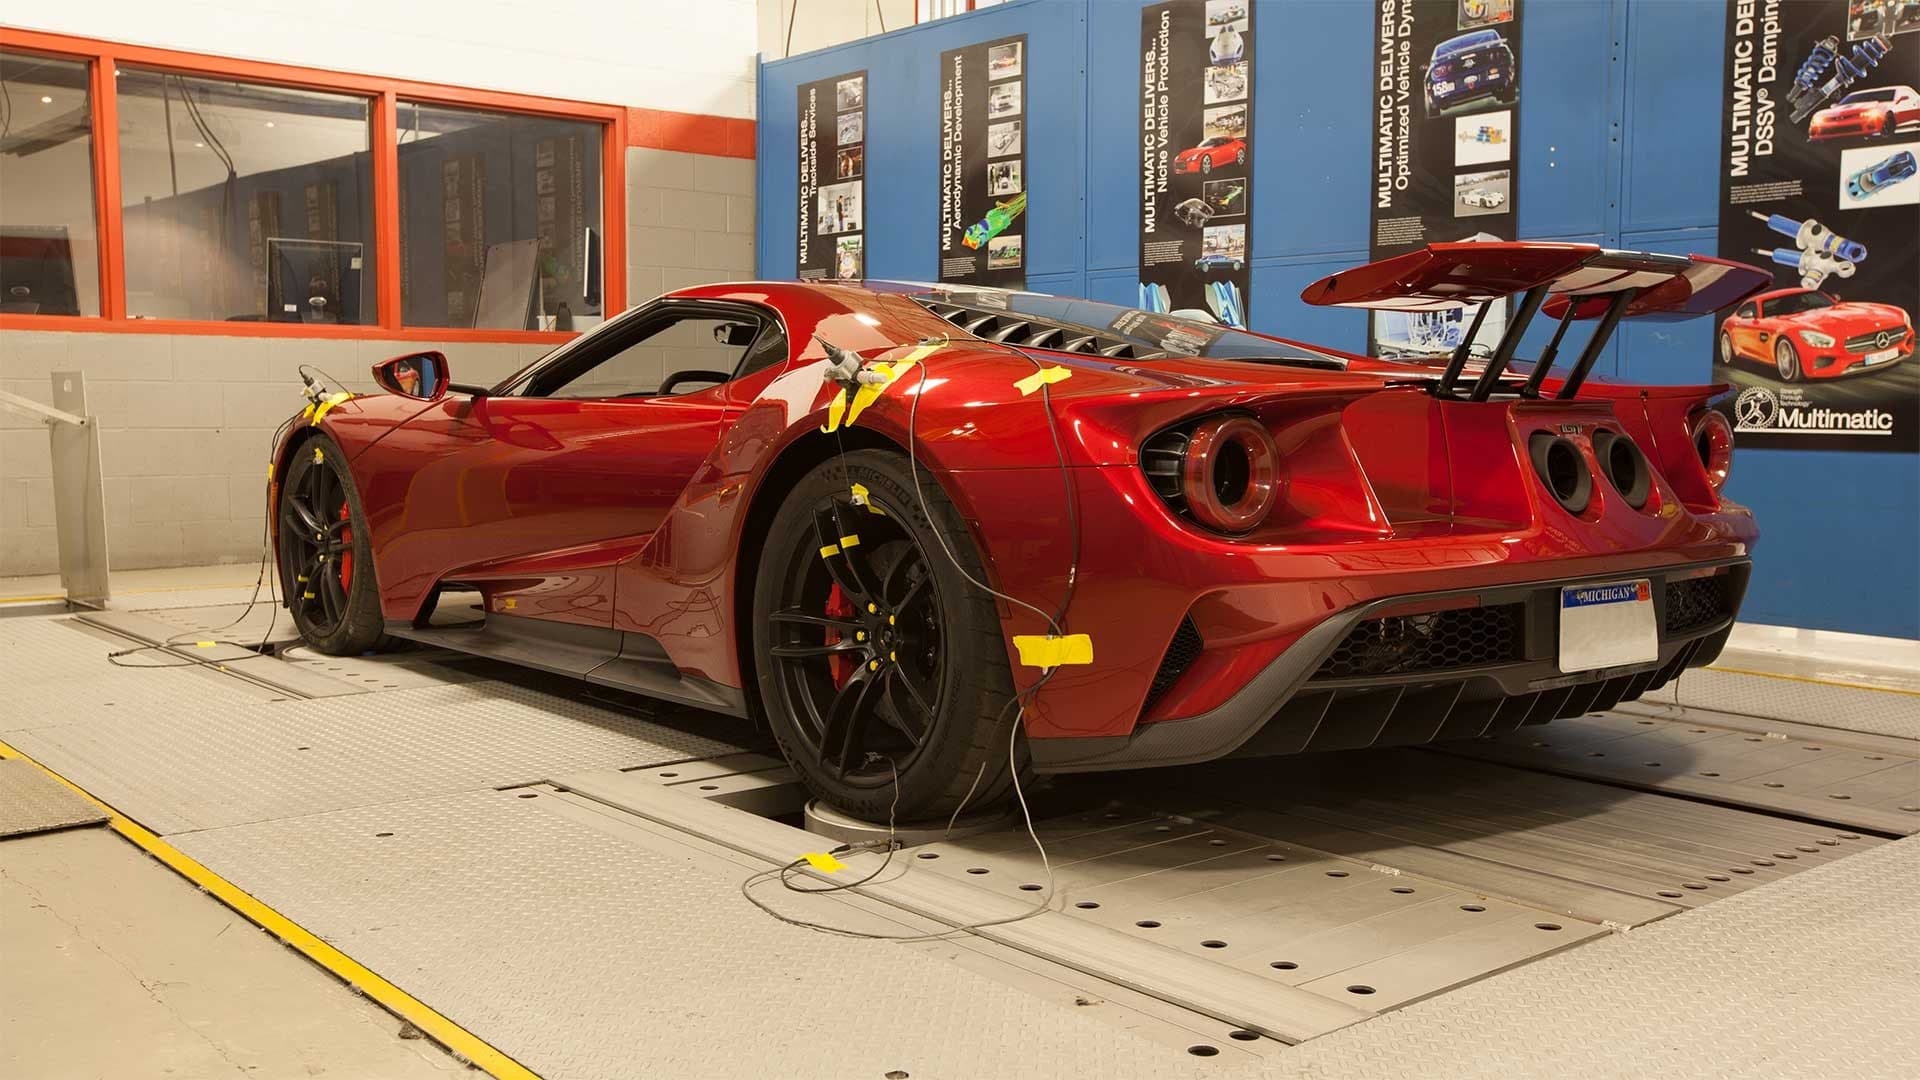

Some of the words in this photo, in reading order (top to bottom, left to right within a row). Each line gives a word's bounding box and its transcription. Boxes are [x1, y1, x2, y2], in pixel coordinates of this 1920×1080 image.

[1158, 10, 1170, 91] Production
[1380, 0, 1395, 90] DELIVERS
[1397, 40, 1411, 103] Vehicle
[1758, 0, 1782, 83] Dampin
[809, 88, 817, 139] Services
[943, 79, 953, 162] DELIVERS...
[953, 55, 963, 140] Development
[1145, 38, 1156, 129] DELIVERS...
[1158, 94, 1169, 148] Vehicle
[1731, 40, 1753, 177] MULTIMATIC
[800, 110, 808, 183] DELIVERS...
[809, 141, 817, 198] Trackside
[953, 142, 962, 229] Aerodynamic
[1145, 131, 1156, 233] MULTIMATIC
[1158, 150, 1168, 193] Niche
[1378, 95, 1393, 208] MULTIMATIC
[1395, 106, 1411, 190] Optimized
[800, 186, 808, 264] MULTIMATIC
[943, 165, 952, 251] MULTIMATIC
[1777, 408, 1893, 430] Multimatic
[1583, 587, 1630, 602] MICHIGAN
